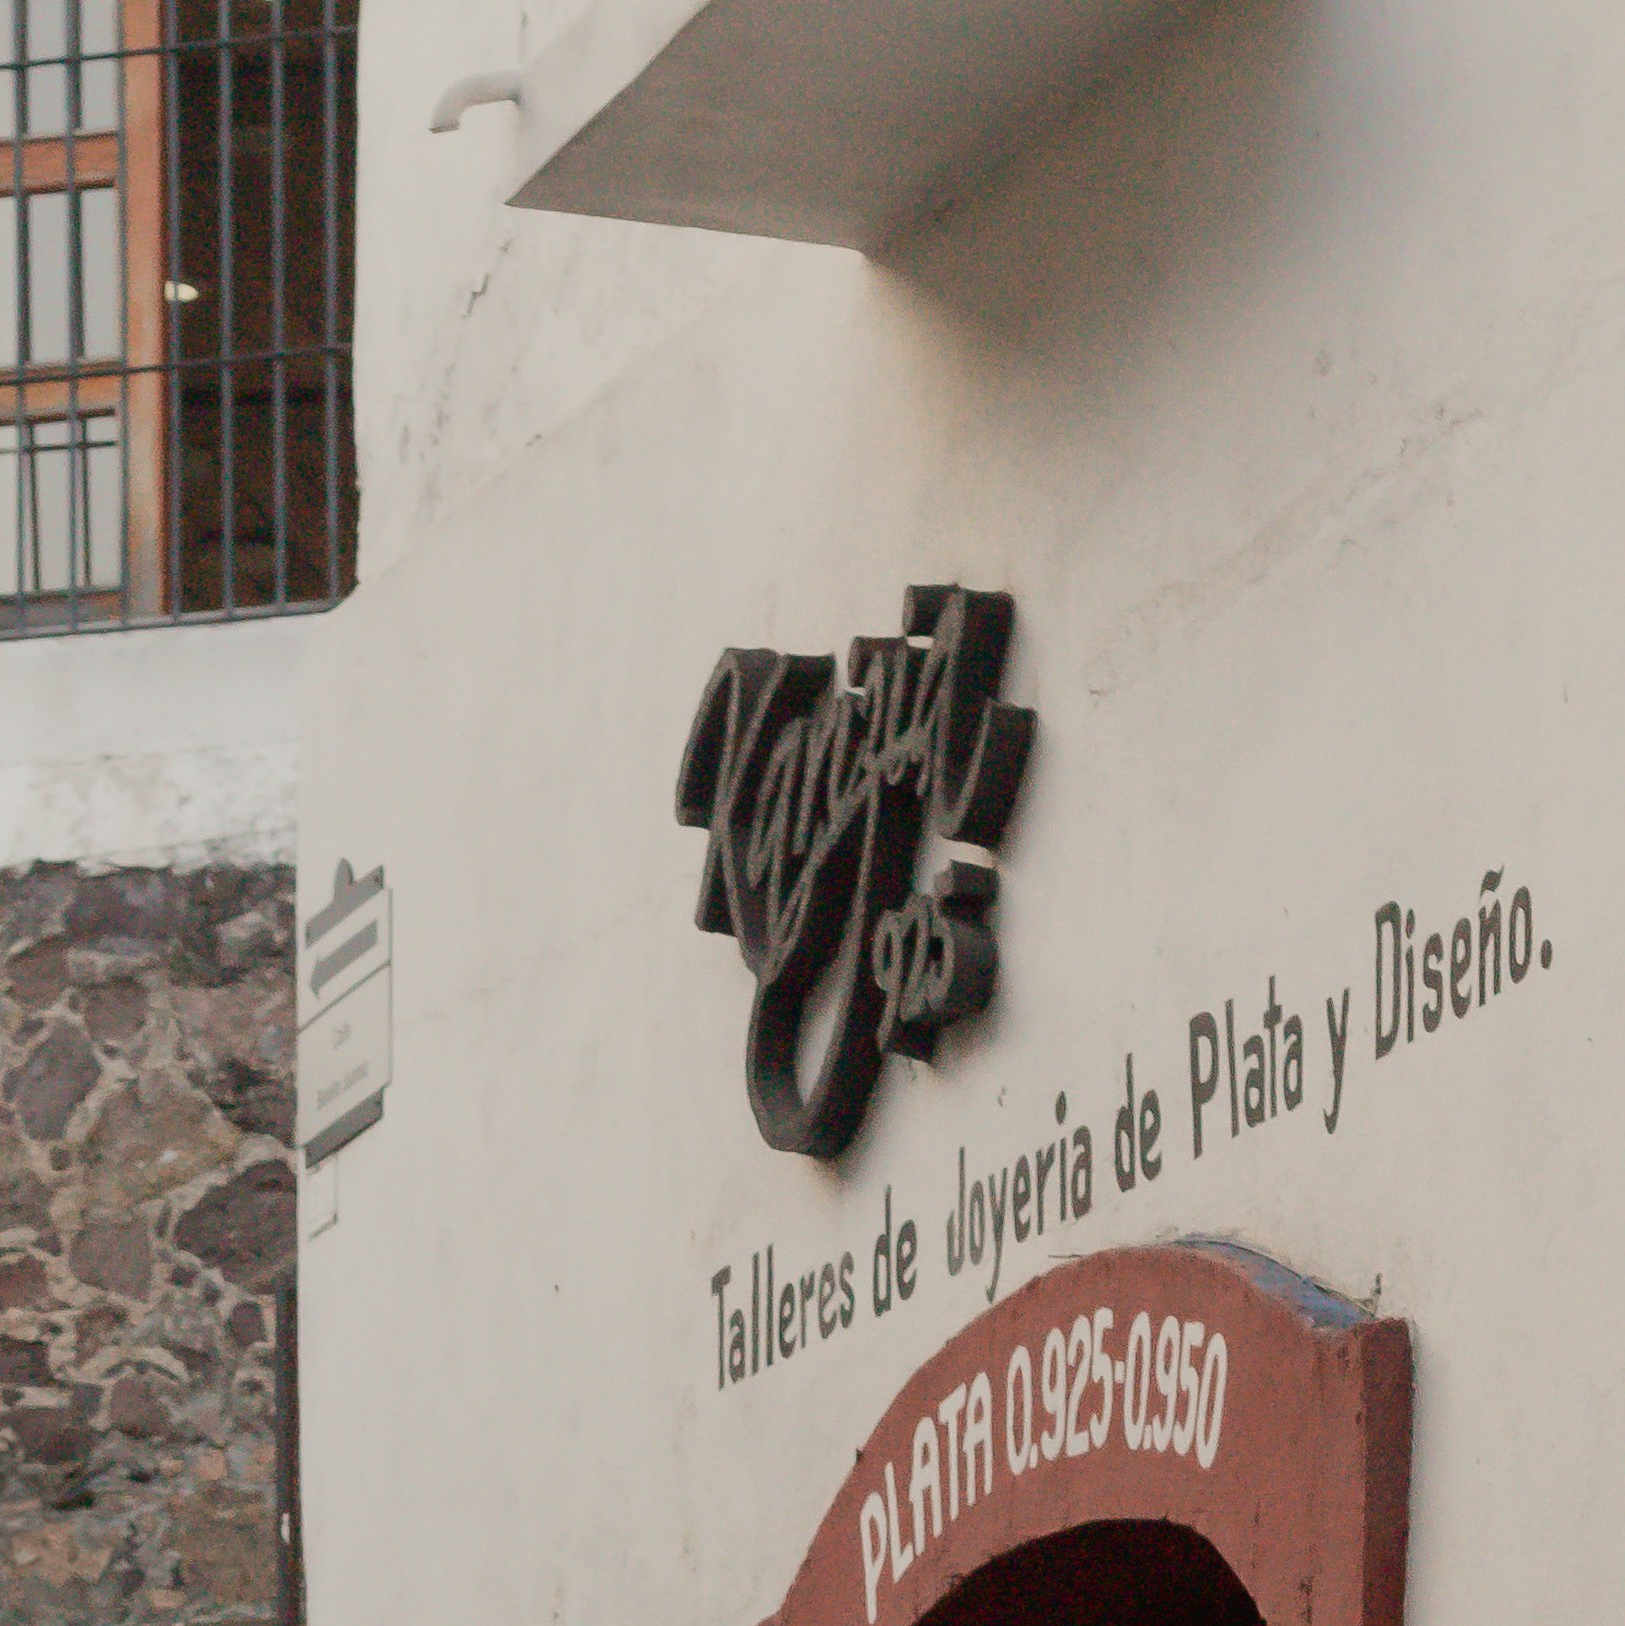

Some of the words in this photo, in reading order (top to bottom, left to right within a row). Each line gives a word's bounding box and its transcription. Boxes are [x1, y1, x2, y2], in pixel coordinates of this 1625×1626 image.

[711, 1243, 855, 1391] Talleres
[873, 1184, 918, 1318] de
[1115, 1052, 1163, 1193] de
[1189, 975, 1304, 1160] Plata
[1323, 987, 1351, 1136] y
[1374, 865, 1553, 1061] Diseño.
[859, 1370, 994, 1626] PLATA
